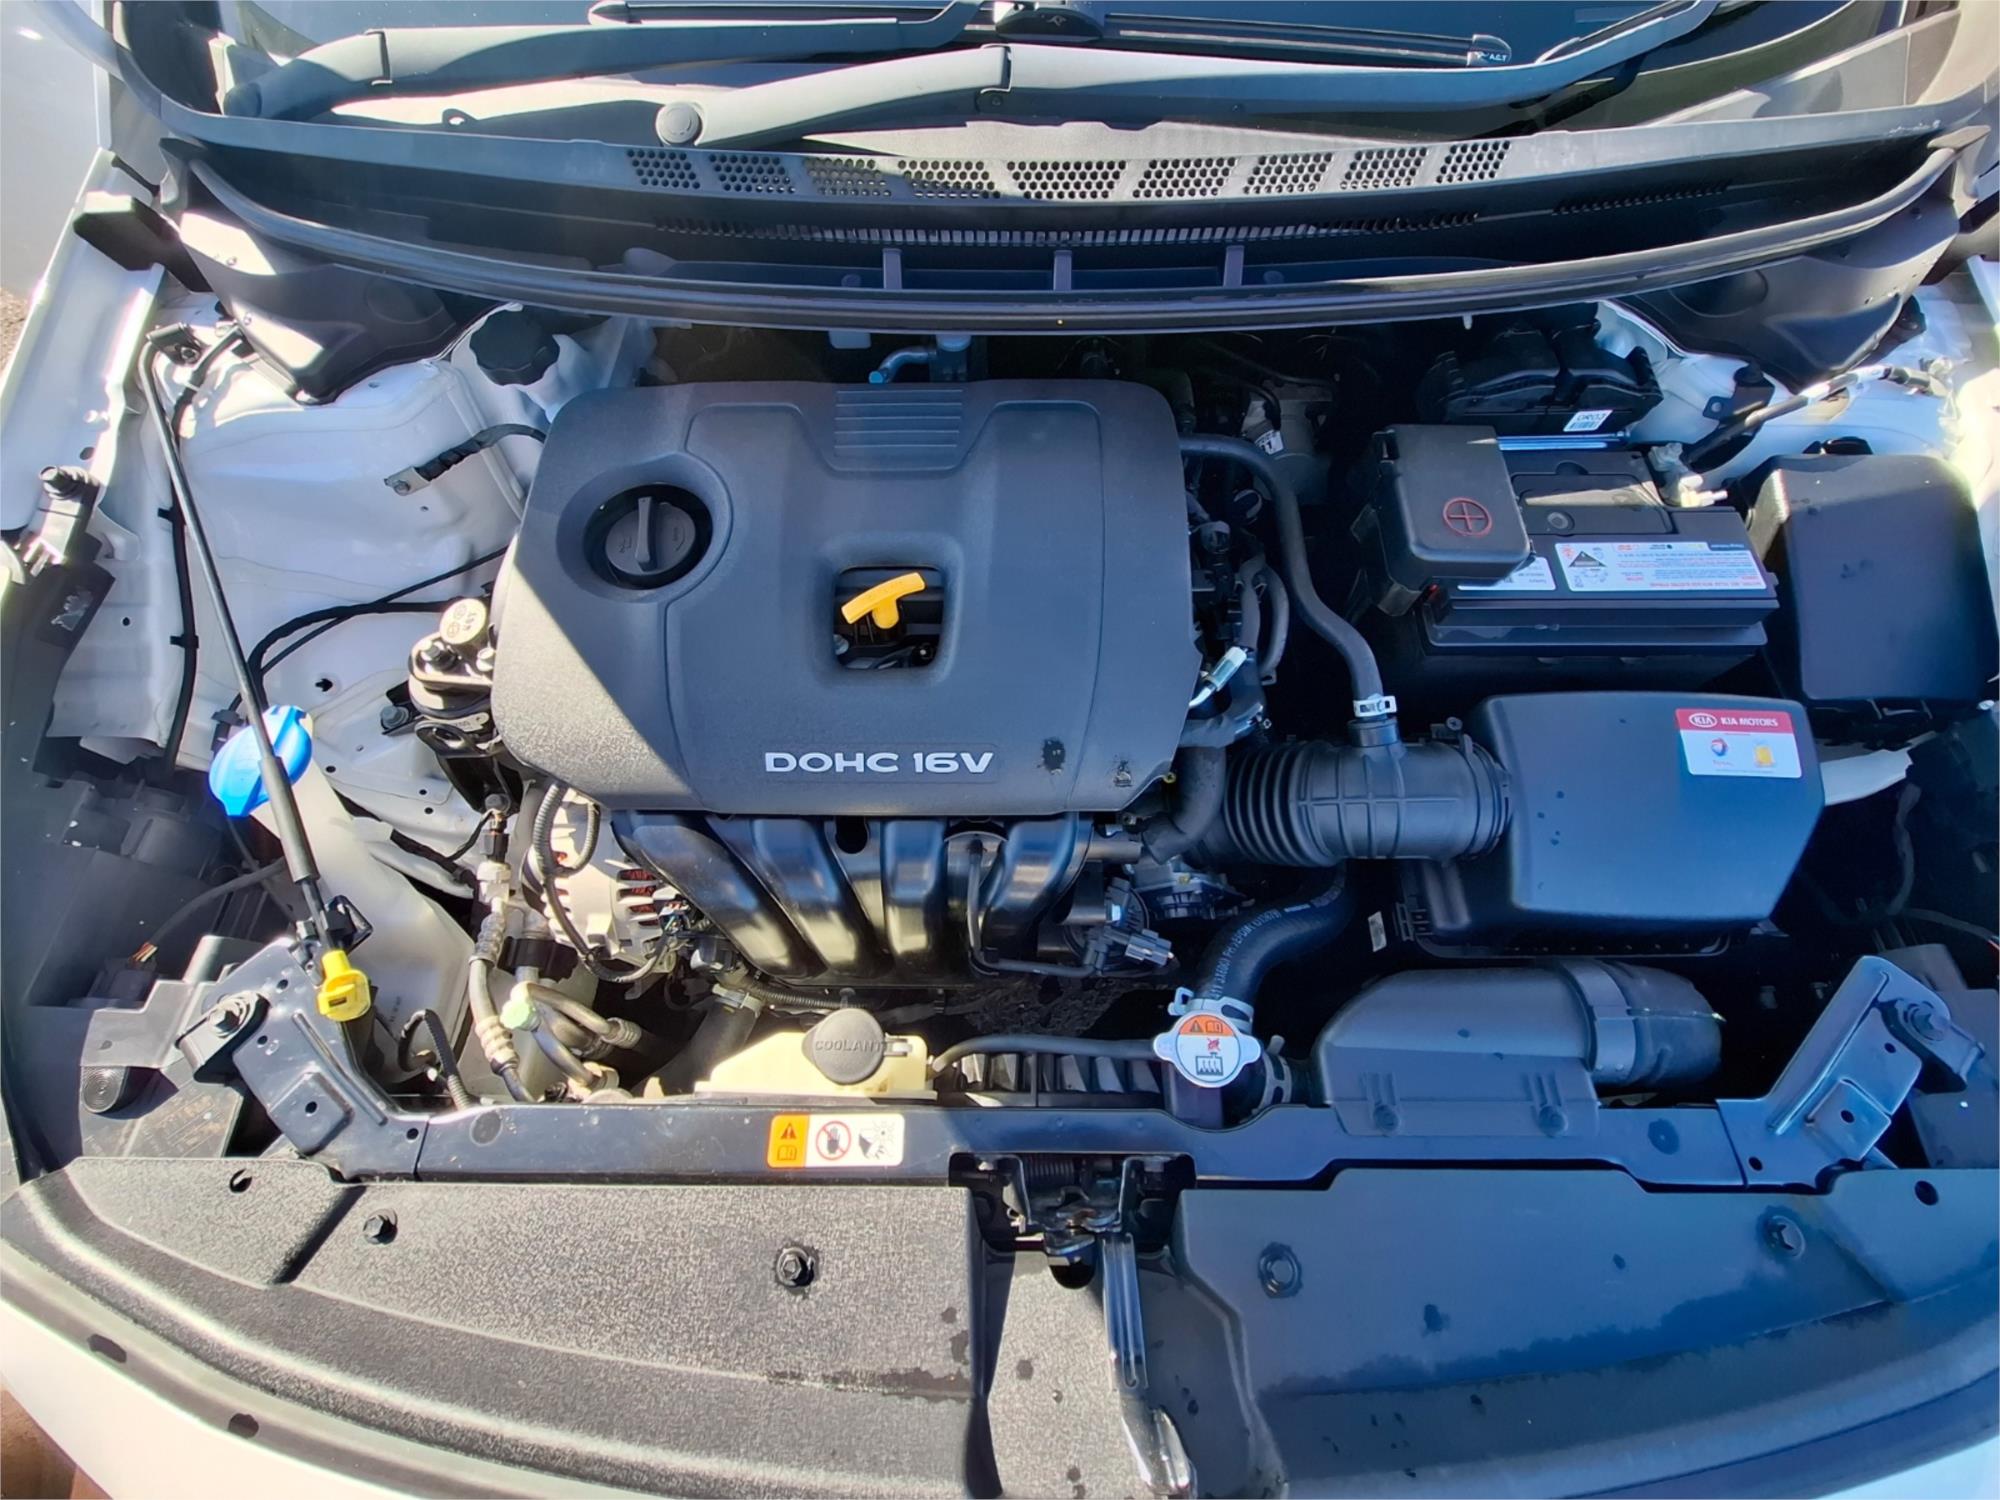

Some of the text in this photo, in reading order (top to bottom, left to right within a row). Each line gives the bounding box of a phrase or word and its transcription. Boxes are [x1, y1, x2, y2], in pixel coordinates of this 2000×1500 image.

[1720, 716, 1778, 727] KIA MOTORS
[765, 752, 994, 773] DOHC 16V
[815, 1039, 884, 1052] COOLANT
